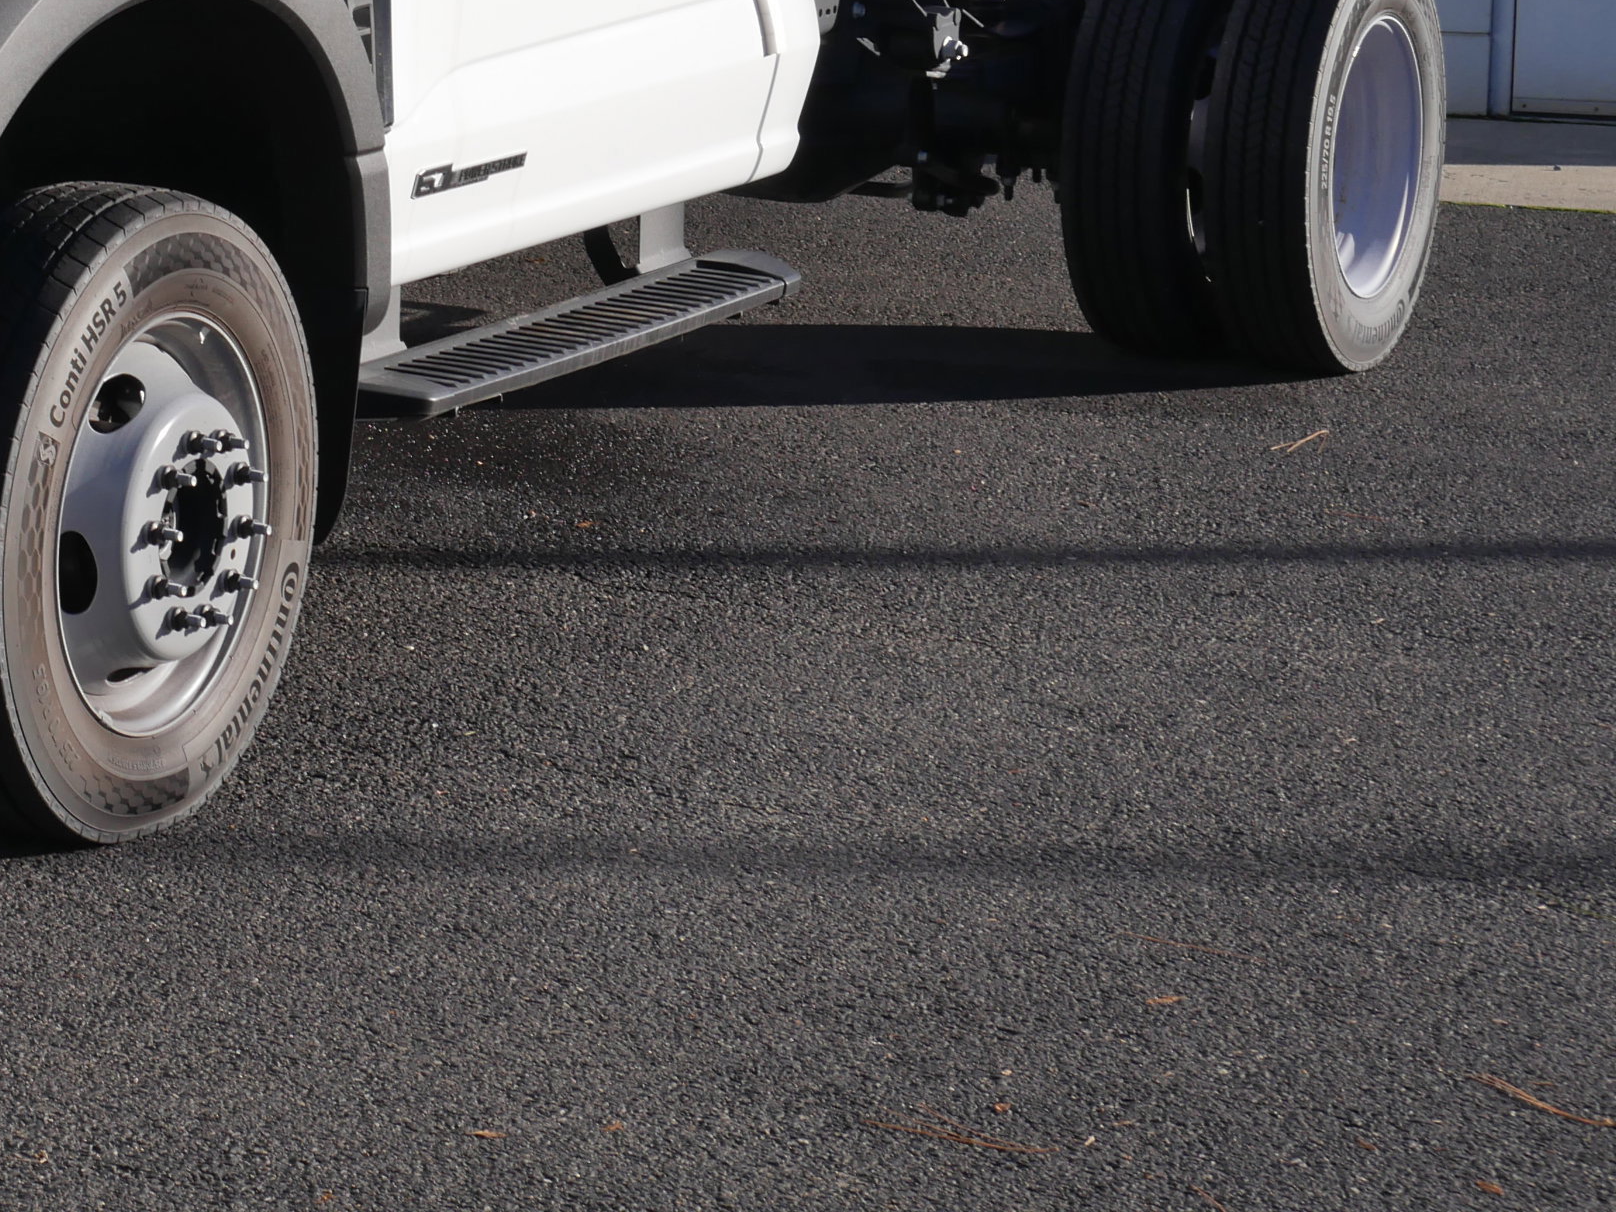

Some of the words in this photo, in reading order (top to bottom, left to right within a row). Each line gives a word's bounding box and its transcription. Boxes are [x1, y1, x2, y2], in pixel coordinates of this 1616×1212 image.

[50, 347, 87, 428] Conti
[81, 297, 117, 355] HSR
[113, 282, 127, 308] 5
[215, 562, 299, 764] Continental
